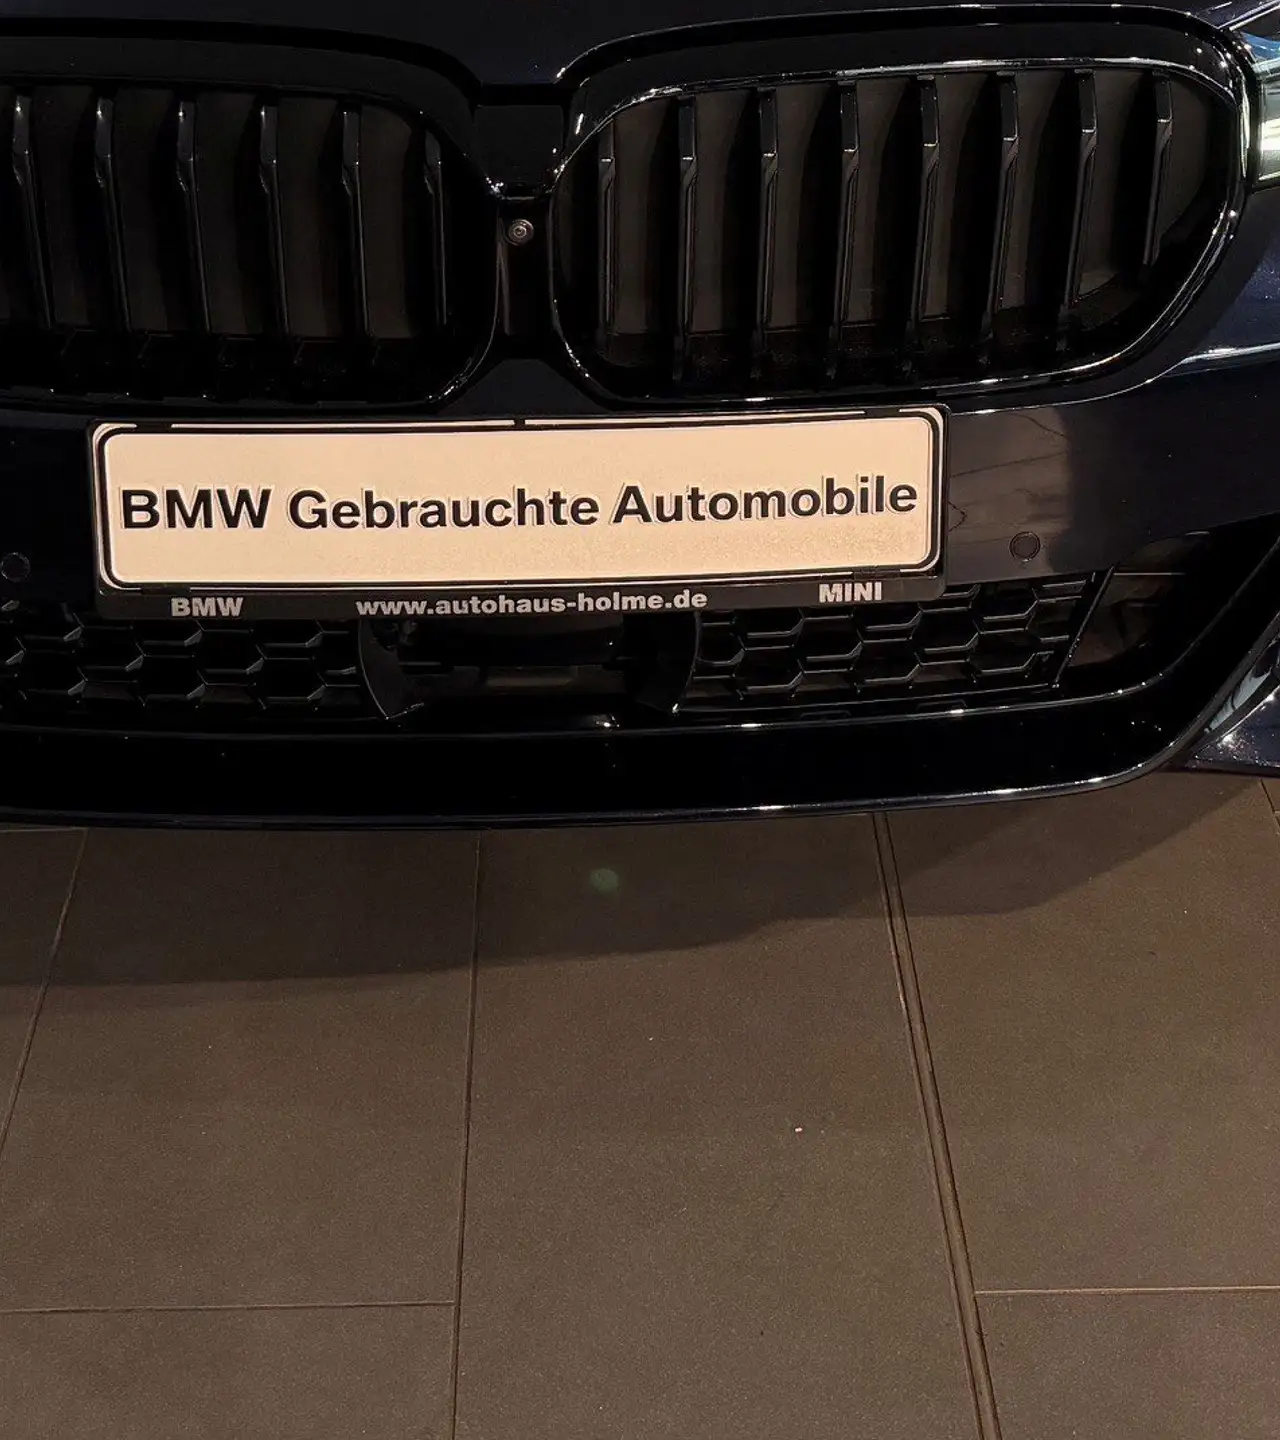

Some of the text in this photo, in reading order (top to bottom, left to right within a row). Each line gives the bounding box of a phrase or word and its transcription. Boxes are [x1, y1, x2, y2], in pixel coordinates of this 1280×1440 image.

[120, 475, 918, 531] BMW Gebrauchte Automobile
[170, 582, 882, 617] BMW www.autohaus-holme.de MINI
